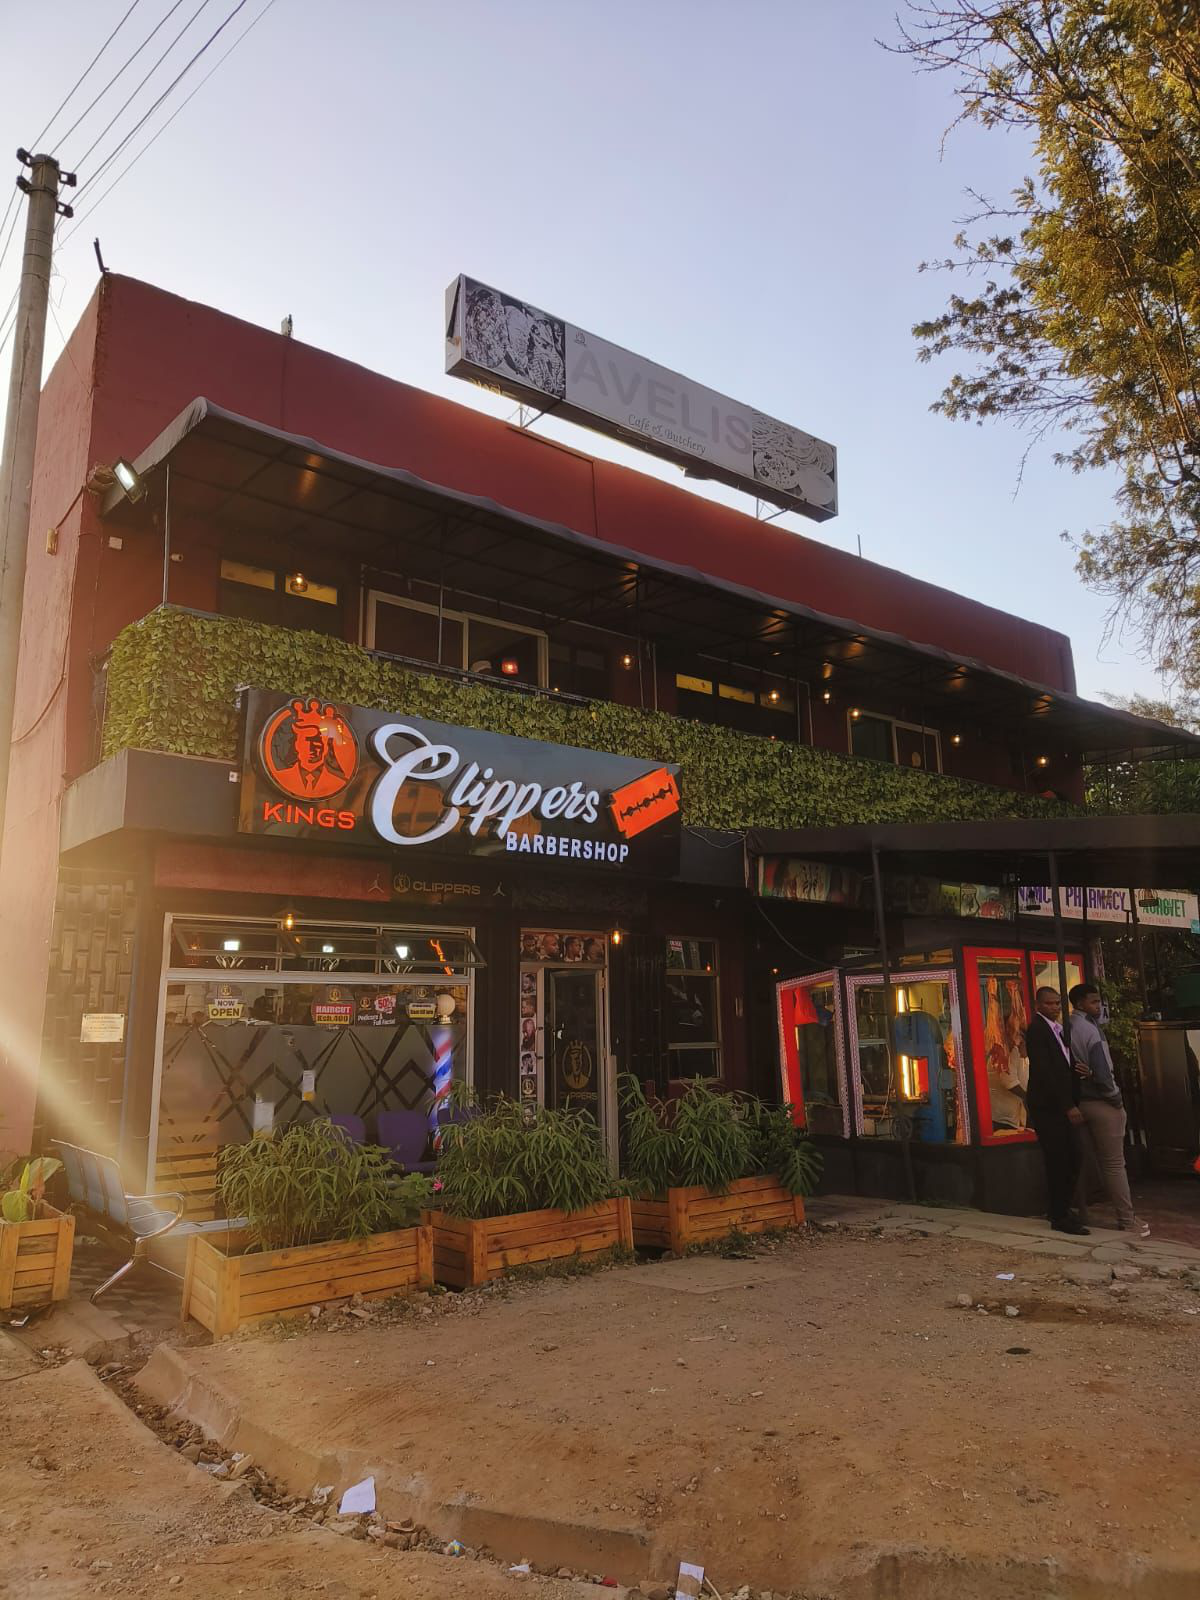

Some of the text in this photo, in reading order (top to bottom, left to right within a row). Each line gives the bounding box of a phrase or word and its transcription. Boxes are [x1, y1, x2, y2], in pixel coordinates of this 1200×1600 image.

[571, 349, 752, 455] AVELIS
[627, 413, 650, 433] Café
[666, 430, 706, 455] Butchery
[372, 723, 600, 846] Clippers
[263, 801, 356, 830] KINGS
[506, 831, 630, 864] BARBERSHOP
[412, 880, 481, 896] CLIPPERS
[1066, 887, 1126, 911] PHRMACY
[211, 1007, 240, 1017] OPEN
[217, 999, 236, 1007] NOW
[315, 1005, 351, 1014] HAIRCUT
